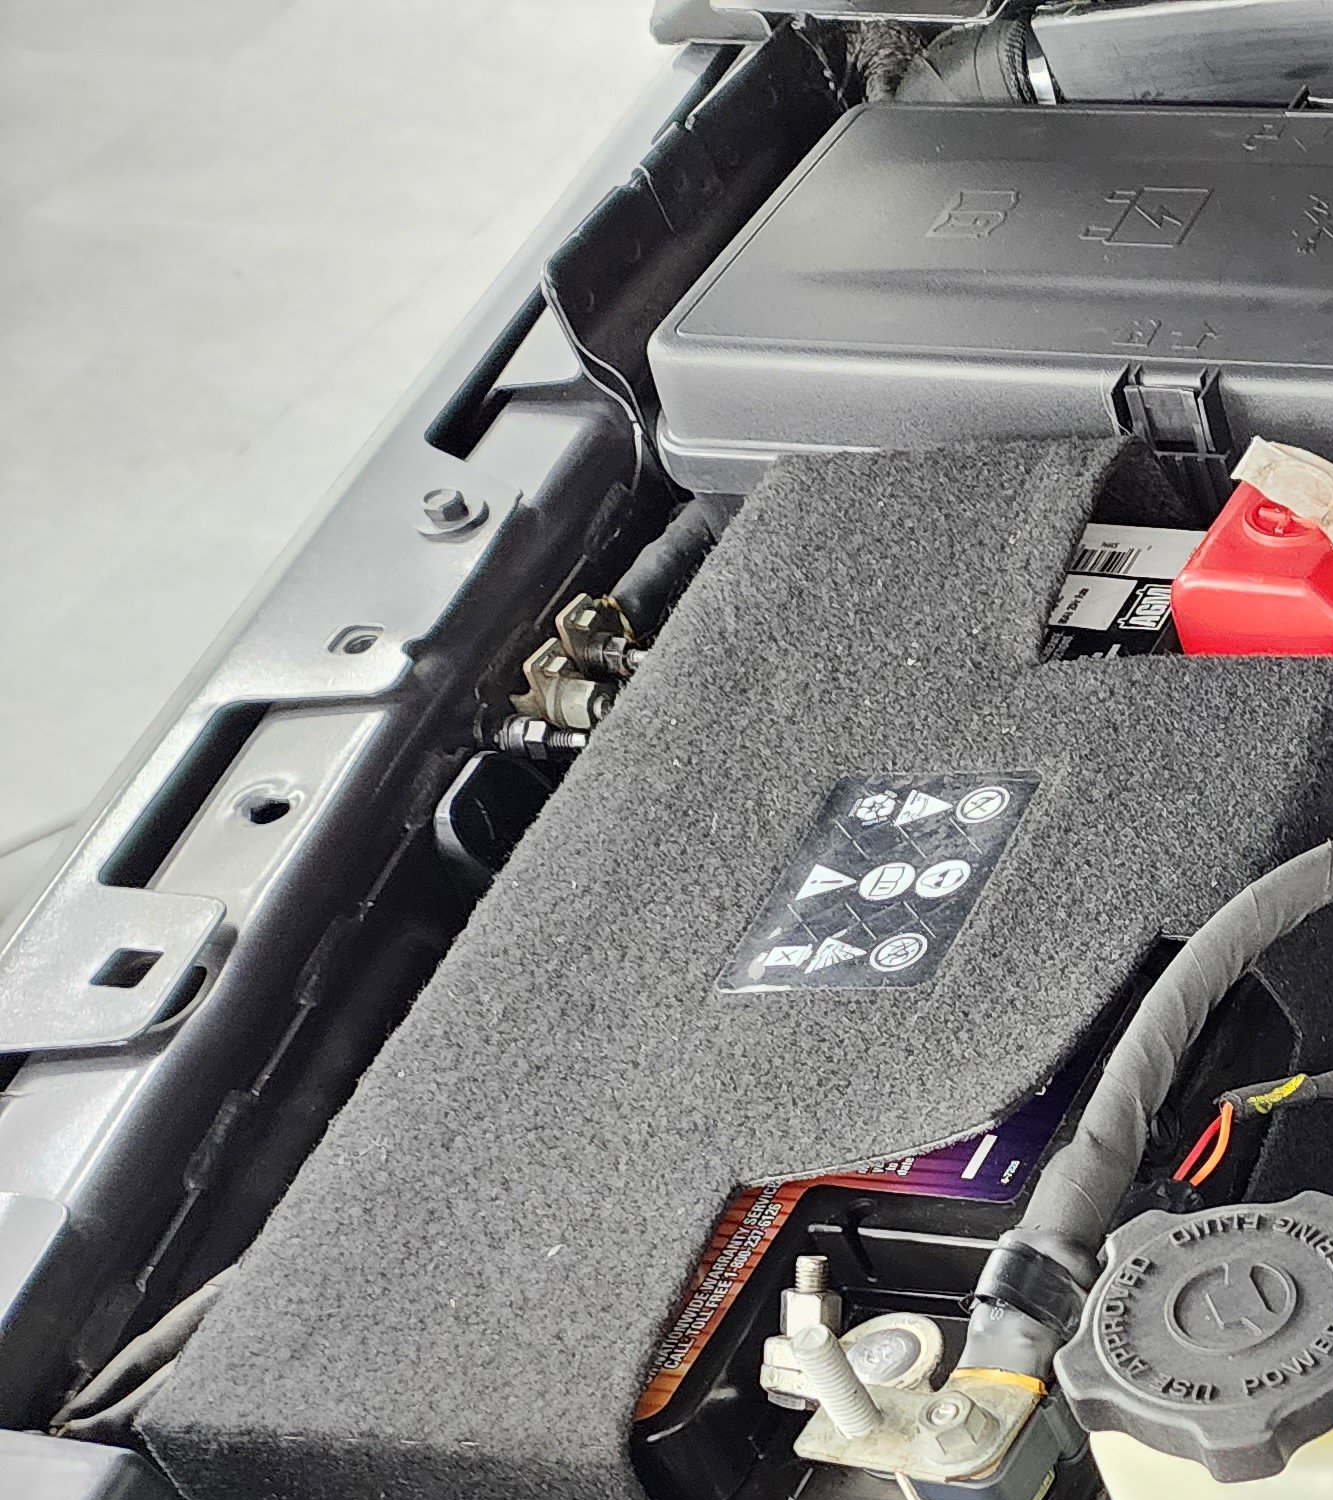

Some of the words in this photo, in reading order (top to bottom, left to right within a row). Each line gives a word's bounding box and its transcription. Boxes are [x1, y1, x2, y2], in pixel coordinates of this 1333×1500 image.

[1129, 587, 1171, 627] AGM
[1168, 1213, 1263, 1247] FLUID
[684, 1308, 716, 1338] TOLL
[704, 1279, 734, 1310] FREE
[729, 1202, 782, 1280] 1-800-237-6126
[702, 1226, 752, 1296] WARRANTY
[1101, 1255, 1152, 1377] APPROVED
[1153, 1372, 1216, 1401] USE
